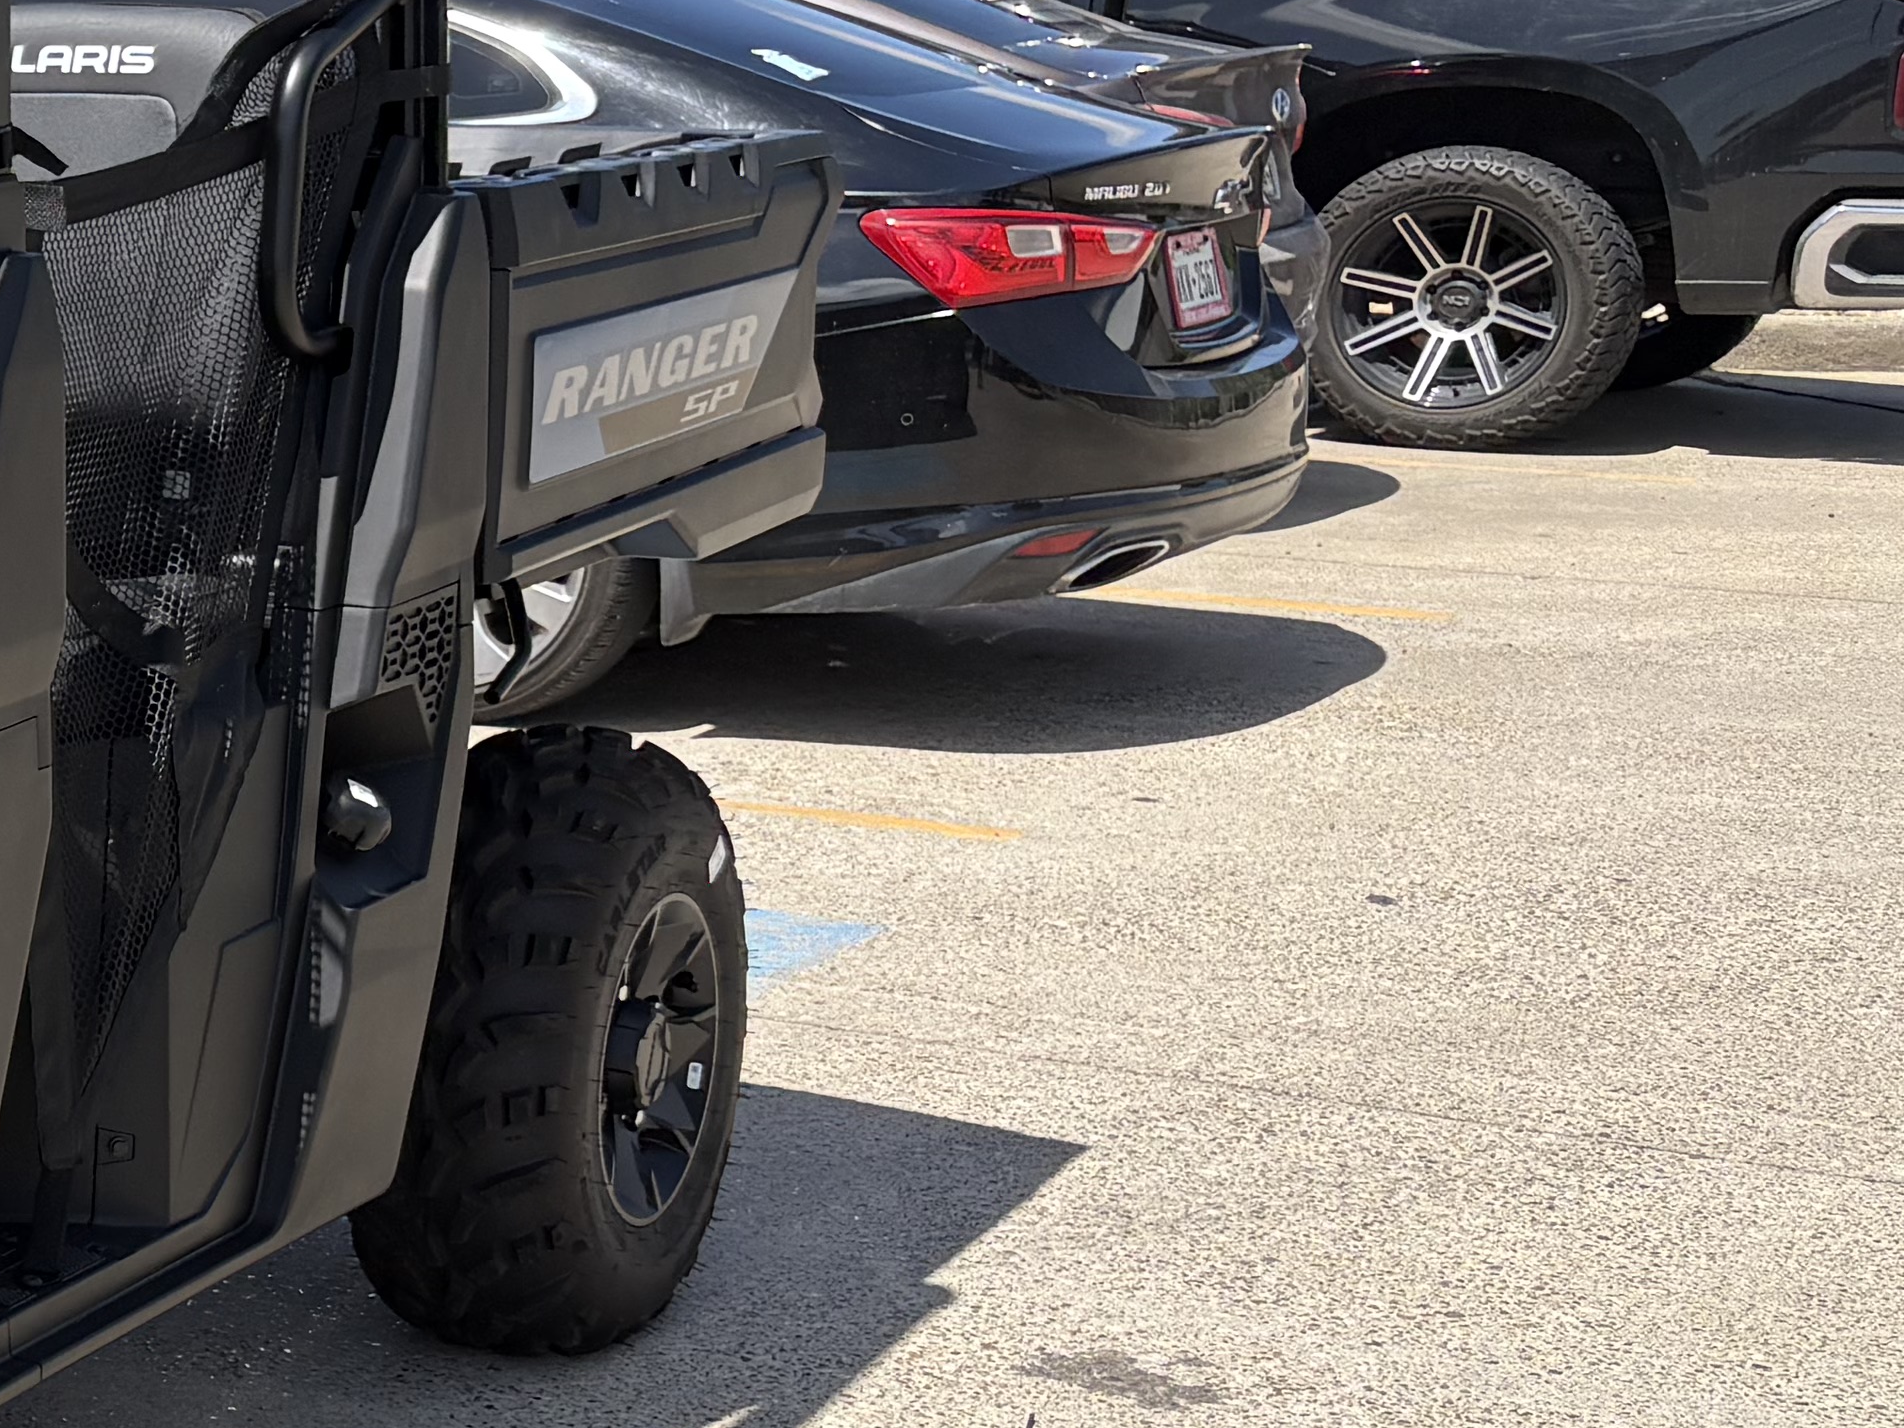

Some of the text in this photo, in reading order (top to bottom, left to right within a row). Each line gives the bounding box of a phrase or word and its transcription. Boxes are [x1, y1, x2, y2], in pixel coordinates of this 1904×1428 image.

[1083, 183, 1140, 201] MALIBU
[542, 314, 759, 426] RANGER
[679, 379, 740, 423] SP
